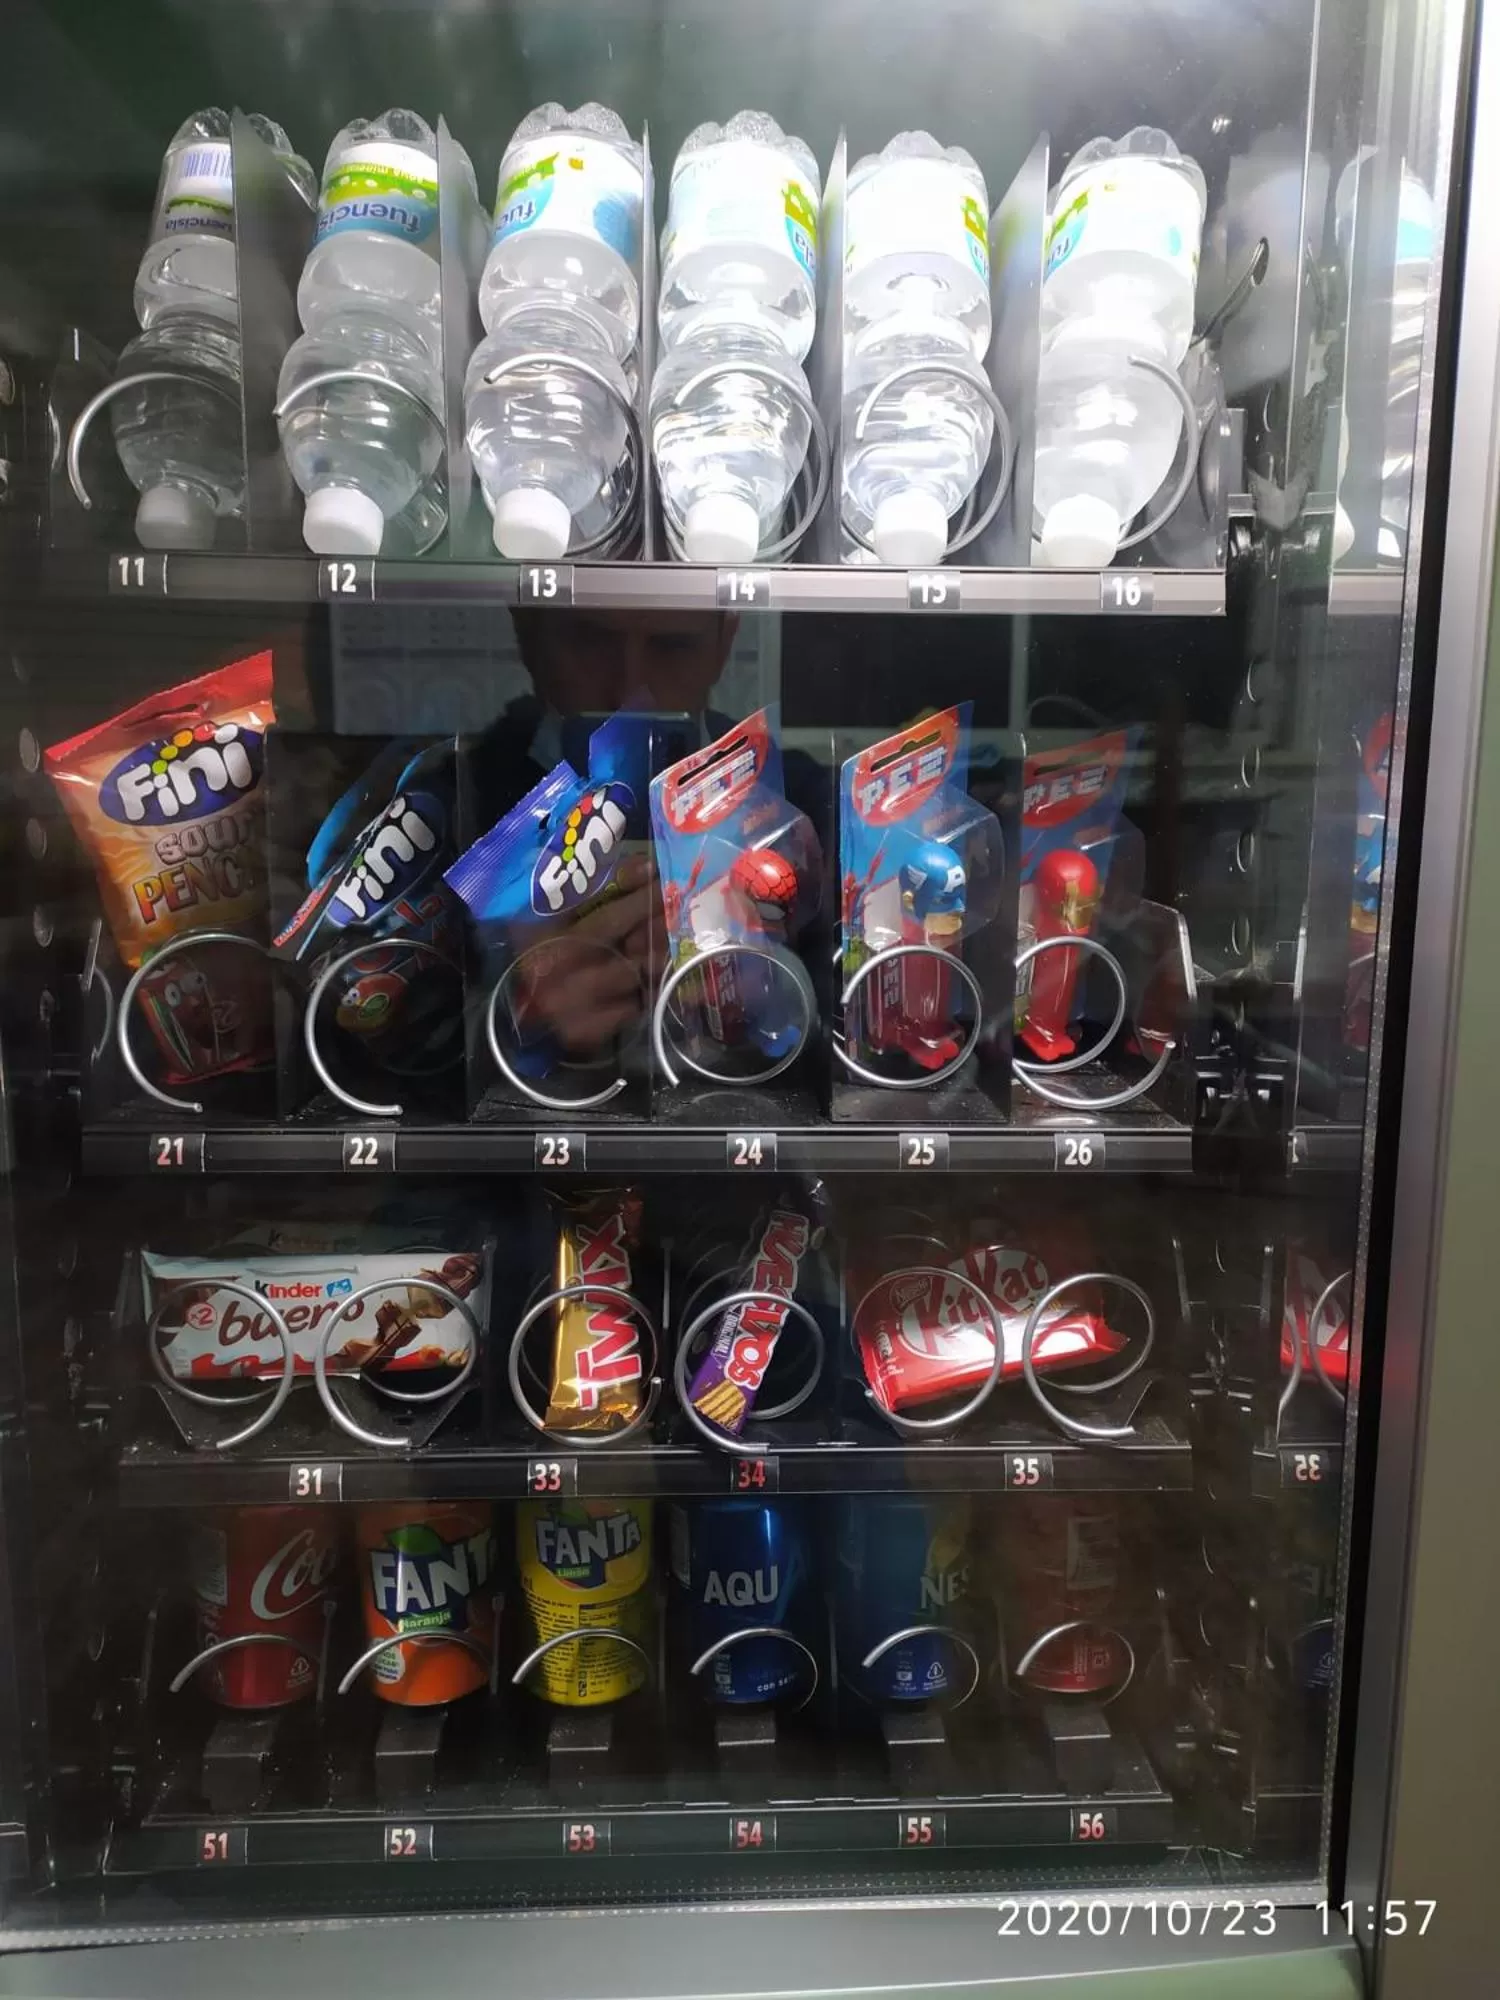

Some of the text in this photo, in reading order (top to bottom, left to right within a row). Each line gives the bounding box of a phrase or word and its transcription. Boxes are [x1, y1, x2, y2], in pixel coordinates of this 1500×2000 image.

[119, 557, 145, 586] 11
[328, 563, 357, 592] 12
[530, 568, 557, 597] 13
[728, 573, 756, 601] 14
[919, 574, 947, 602] 15
[1112, 576, 1141, 605] 16
[117, 723, 252, 821] Fini
[858, 746, 947, 816] PEZ
[670, 749, 756, 826] PEZ
[1024, 765, 1108, 814] PEZ
[540, 787, 626, 910] Fini
[158, 1137, 184, 1165] 21
[350, 1137, 378, 1165] 22
[542, 1136, 570, 1165] 23
[735, 1137, 762, 1165] 24
[908, 1137, 935, 1165] 25
[1064, 1138, 1092, 1165] 26
[575, 1214, 642, 1410] TWIX
[297, 1467, 322, 1495] 31
[535, 1463, 561, 1490] 33
[739, 1459, 766, 1487] 34
[1013, 1457, 1039, 1484] 35
[536, 1513, 641, 1565] FANTA
[703, 1564, 779, 1607] AQU
[400, 1611, 451, 1632] Naranja
[569, 1824, 595, 1851] 53
[737, 1821, 762, 1848] 54
[907, 1817, 932, 1844] 55
[1079, 1812, 1104, 1838] 56
[204, 1832, 228, 1860] 51
[391, 1828, 416, 1855] 52
